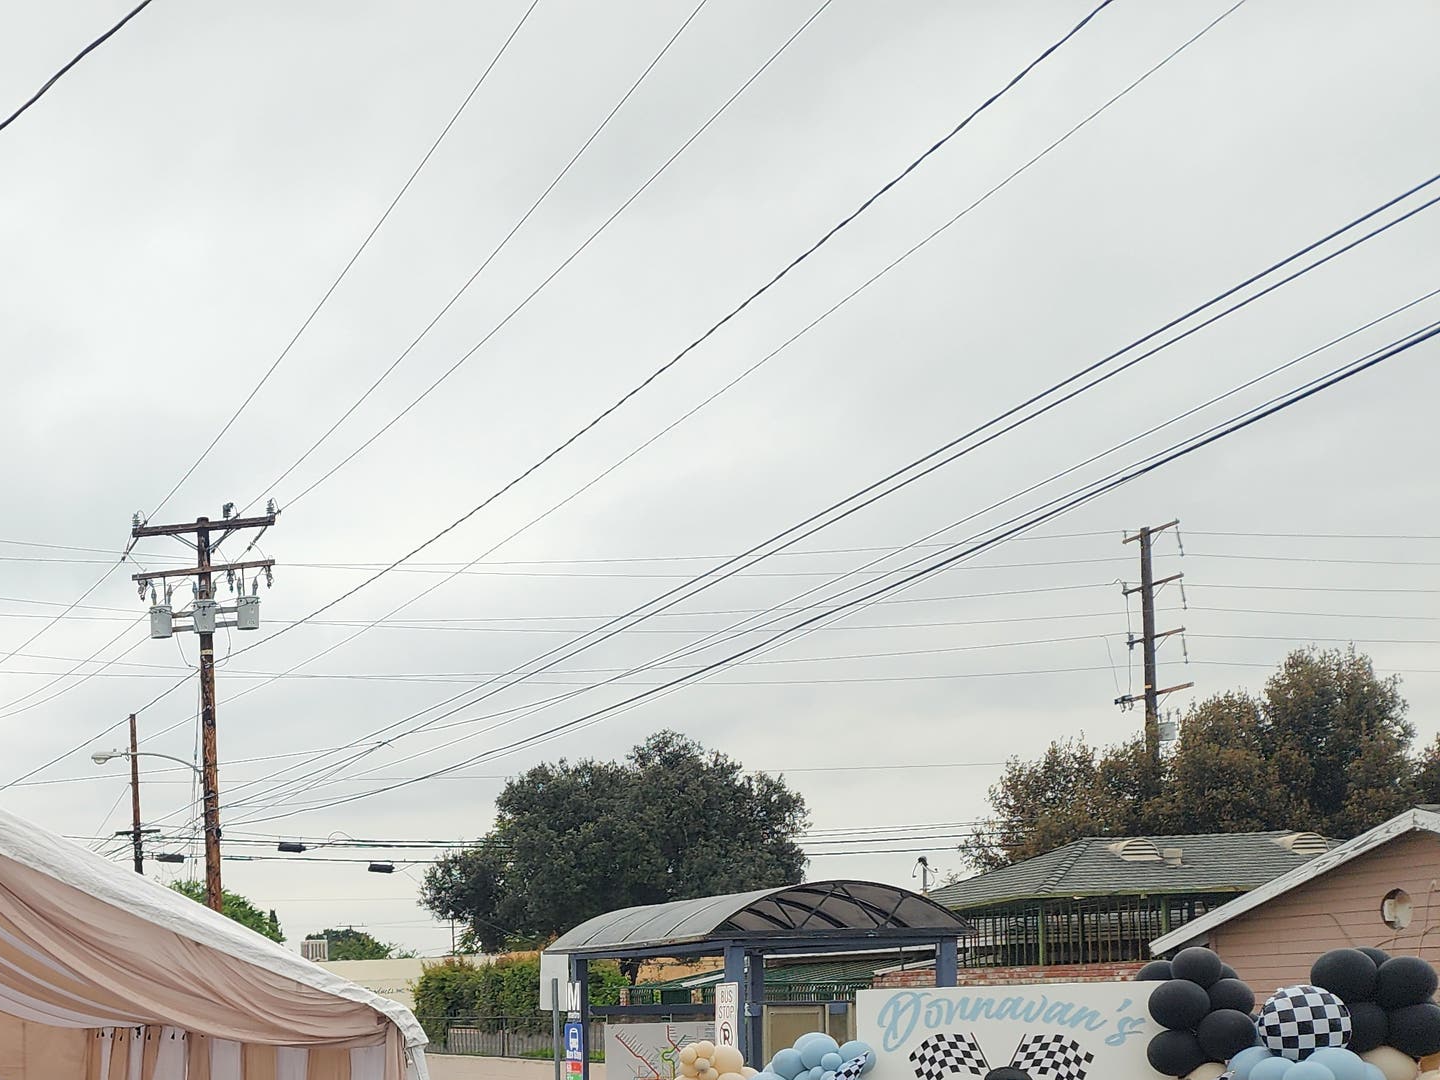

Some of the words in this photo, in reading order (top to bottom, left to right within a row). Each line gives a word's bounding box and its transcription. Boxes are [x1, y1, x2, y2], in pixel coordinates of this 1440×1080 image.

[720, 989, 733, 1004] BUS
[719, 1005, 735, 1019] STOP
[876, 991, 1147, 1053] Donnavan's
